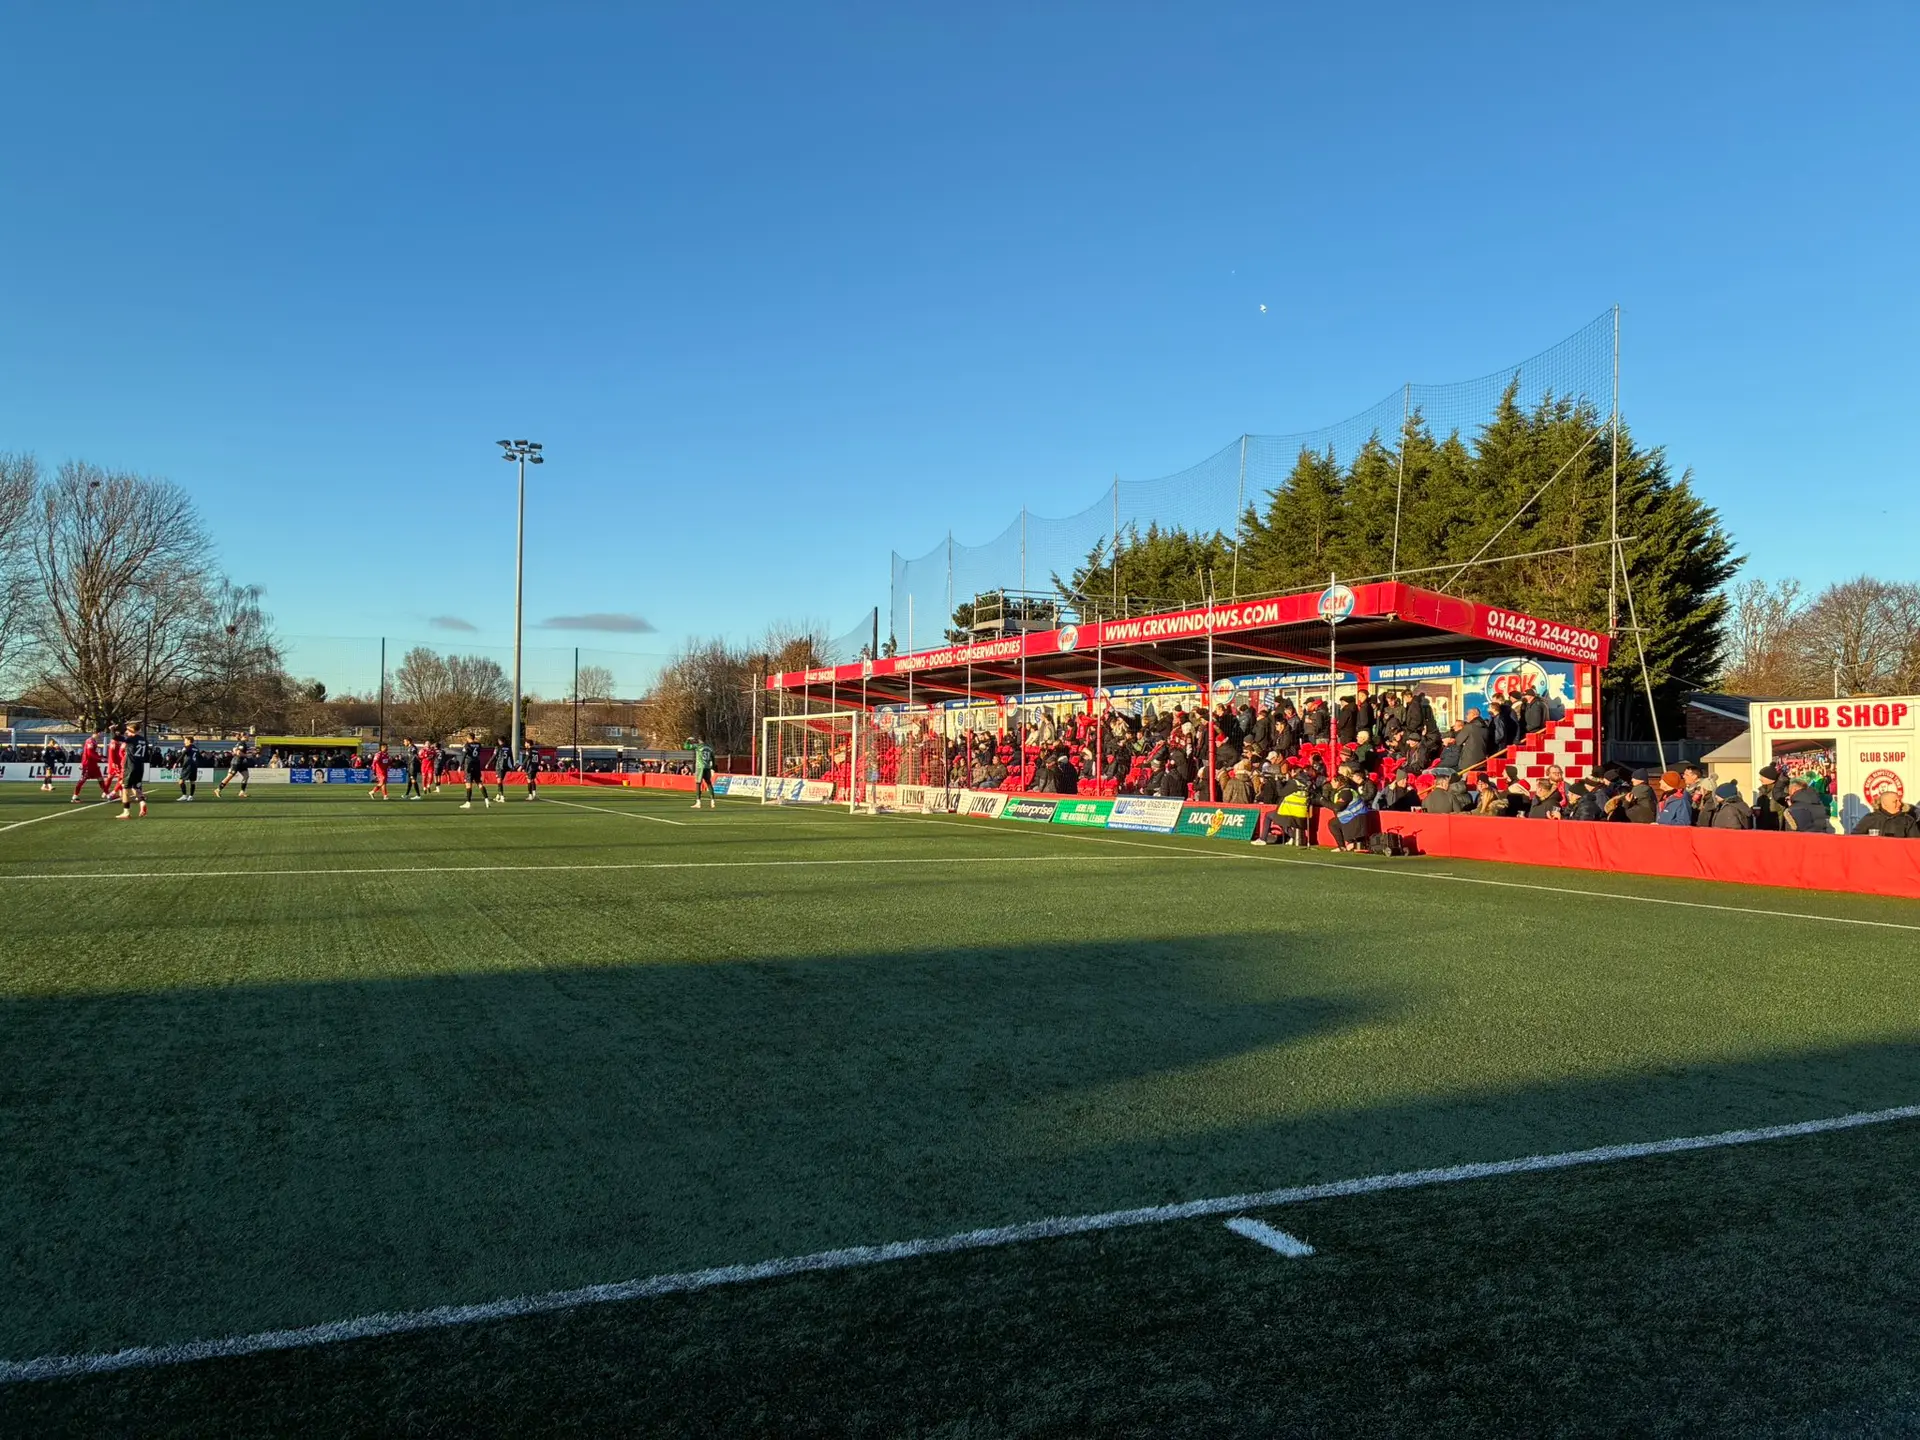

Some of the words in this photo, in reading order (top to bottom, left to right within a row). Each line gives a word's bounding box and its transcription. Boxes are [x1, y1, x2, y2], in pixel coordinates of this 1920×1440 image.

[1105, 603, 1279, 641] WWW.CRKWINDOWS.COM
[1487, 610, 1537, 636] 01442
[1541, 624, 1599, 650] 244200
[1486, 626, 1598, 660] WWW.CRKWINDOWS.COM
[895, 656, 926, 671] WINDOWS
[929, 651, 953, 666] DOORS
[956, 639, 1021, 662] CONSERVATORIES
[1379, 669, 1395, 678] VISIT
[1395, 667, 1409, 677] OUR
[1410, 664, 1451, 677] SHOWROOM
[1494, 673, 1538, 694] CRK
[1768, 706, 1830, 730] CLUB
[1837, 703, 1908, 728] SHOP
[134, 744, 146, 757] 21
[472, 747, 478, 757] 6
[1860, 751, 1881, 763] CLUB
[1883, 751, 1906, 762] SHOP
[1007, 803, 1054, 816] enterprise
[1188, 811, 1212, 824] DUCK
[1222, 814, 1245, 827] TAPE
